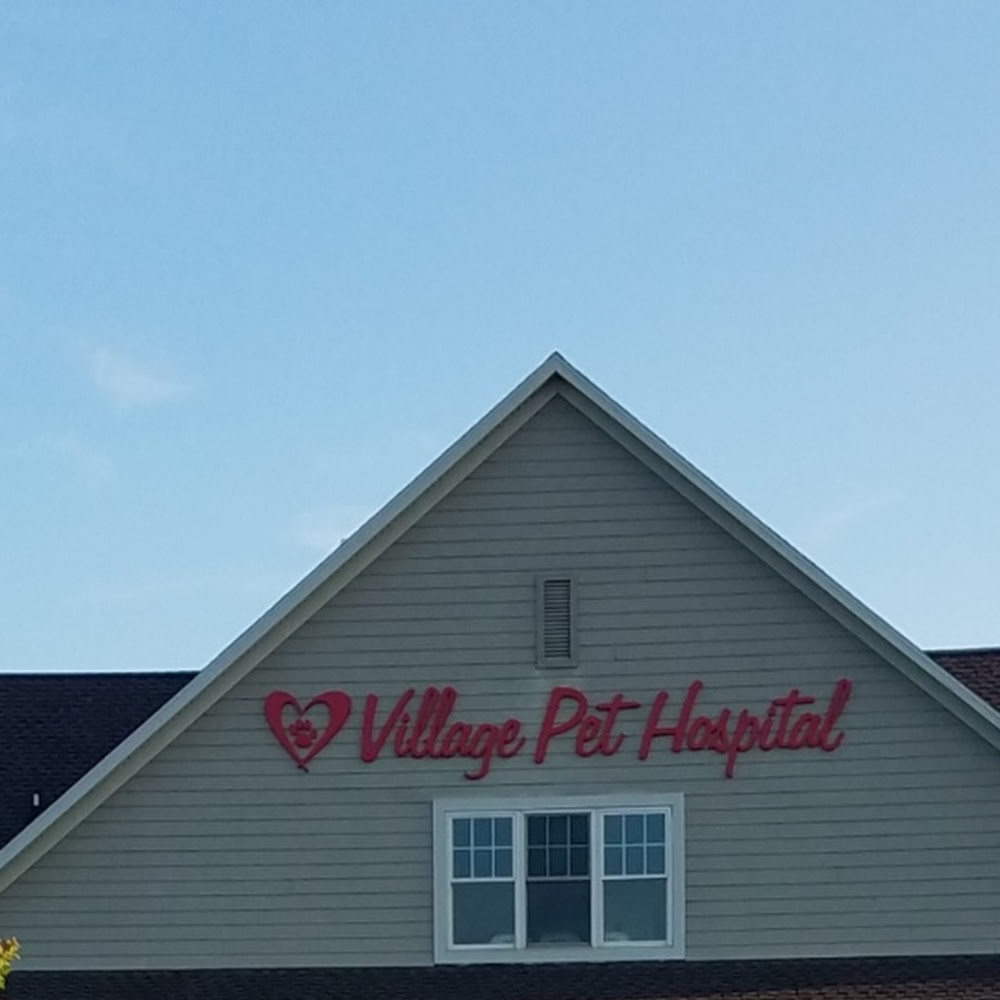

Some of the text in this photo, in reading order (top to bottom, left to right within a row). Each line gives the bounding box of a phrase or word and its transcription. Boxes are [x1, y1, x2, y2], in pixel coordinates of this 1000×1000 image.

[360, 678, 853, 780] Village Pet Hospital
